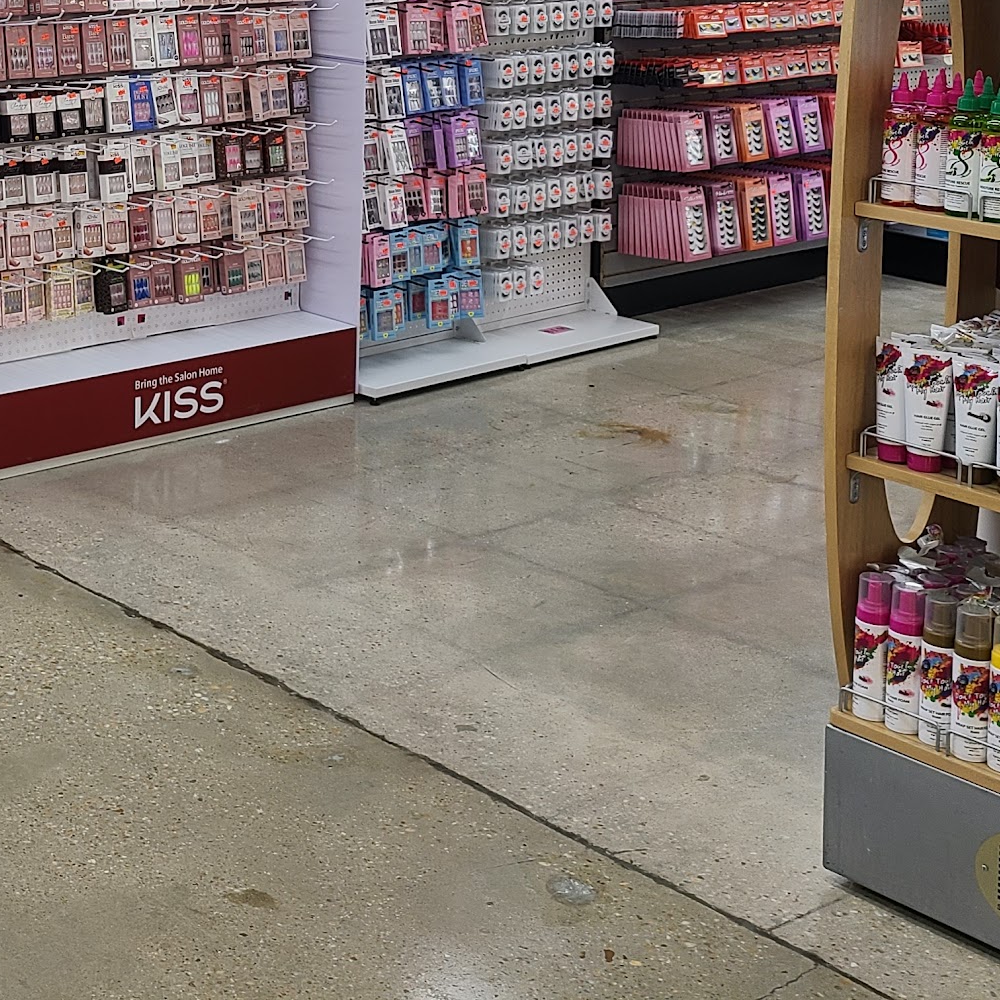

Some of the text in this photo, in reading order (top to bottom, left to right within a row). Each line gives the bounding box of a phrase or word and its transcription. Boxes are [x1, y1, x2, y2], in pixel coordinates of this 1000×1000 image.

[135, 366, 223, 390] Bring the Salon Home
[135, 381, 224, 429] KISS
